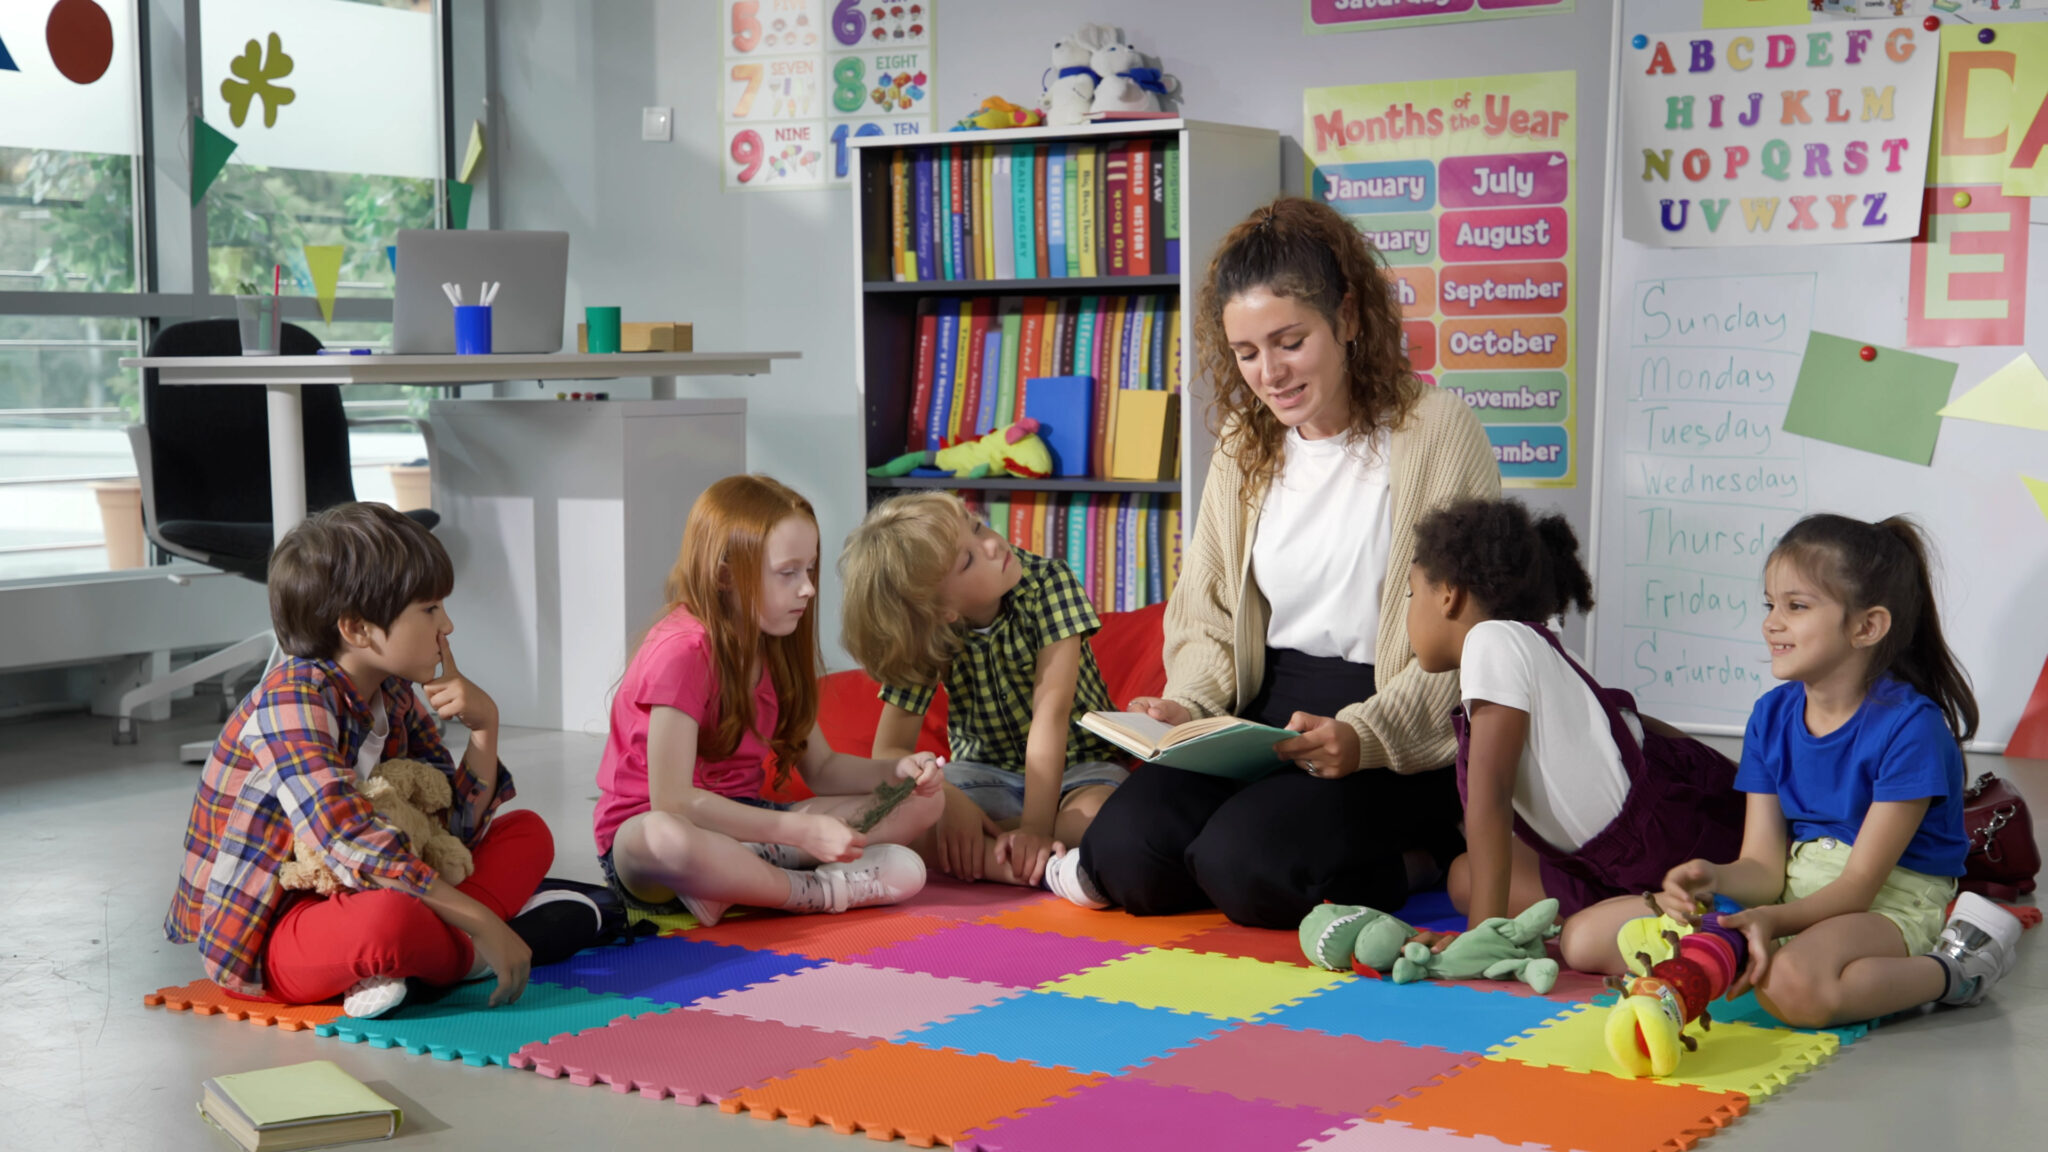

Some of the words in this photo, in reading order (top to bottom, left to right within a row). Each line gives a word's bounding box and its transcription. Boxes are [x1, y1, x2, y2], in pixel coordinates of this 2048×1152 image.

[732, 0, 762, 53] 5
[832, 0, 866, 46] 6
[771, 61, 814, 76] SEVEN
[876, 55, 919, 70] EIGHT
[731, 63, 764, 118] 7
[832, 56, 868, 113] 8
[1453, 91, 1472, 110] of
[775, 127, 811, 142] NINE
[893, 122, 920, 136] TEN
[1312, 102, 1446, 152] Months
[1450, 112, 1482, 133] the
[1483, 93, 1570, 139] Year
[730, 129, 764, 183] 9
[1133, 152, 1144, 195] WORLD
[1051, 164, 1062, 237] MEDICINE
[1154, 163, 1162, 203] LAW
[1324, 174, 1426, 200] January
[1471, 165, 1535, 198] July
[953, 215, 962, 275] POLITICS
[1018, 197, 1028, 258] SURGERY
[1133, 205, 1144, 260] HISTORY
[1362, 228, 1432, 255] ruary
[1455, 217, 1552, 250] August
[1924, 212, 2011, 319] E
[1443, 278, 1563, 309] September
[1642, 280, 1787, 344] Sunday
[972, 327, 983, 368] Vector
[1450, 329, 1558, 357] October
[940, 361, 948, 376] of
[1639, 356, 1774, 399] Monday
[931, 377, 948, 441] Relativity
[1491, 440, 1561, 464] ember
[1641, 406, 1772, 456] Tuesday
[1641, 463, 1799, 498] Wednesday
[1643, 577, 1748, 630] Friday
[1633, 631, 1763, 698] Saturday
